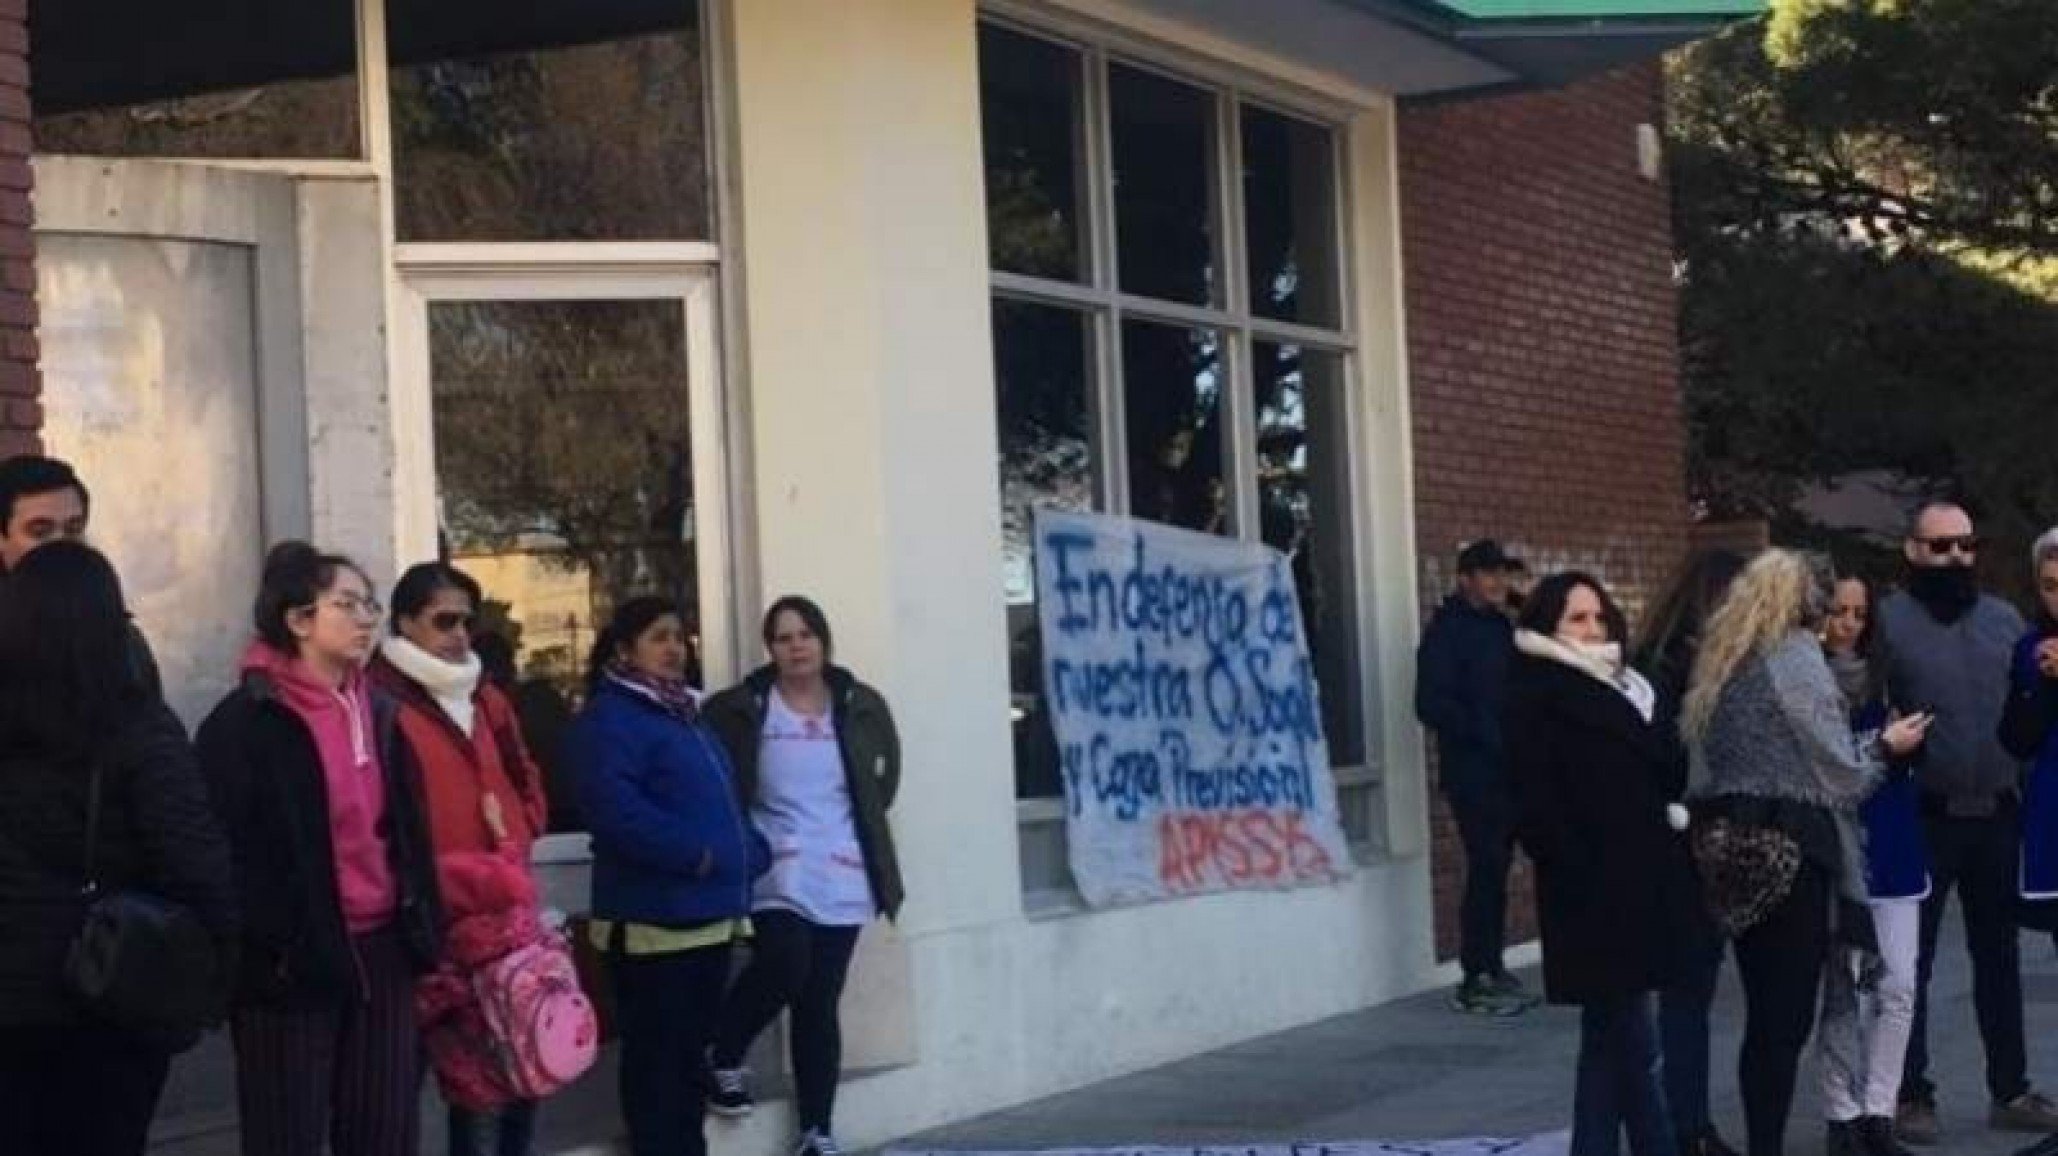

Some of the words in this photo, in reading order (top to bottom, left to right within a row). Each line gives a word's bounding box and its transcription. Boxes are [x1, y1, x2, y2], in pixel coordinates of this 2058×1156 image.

[1046, 532, 1120, 636] En
[1259, 556, 1297, 646] de
[1054, 637, 1193, 721] nuestra
[1066, 742, 1084, 818] y
[1089, 731, 1161, 822] Caja
